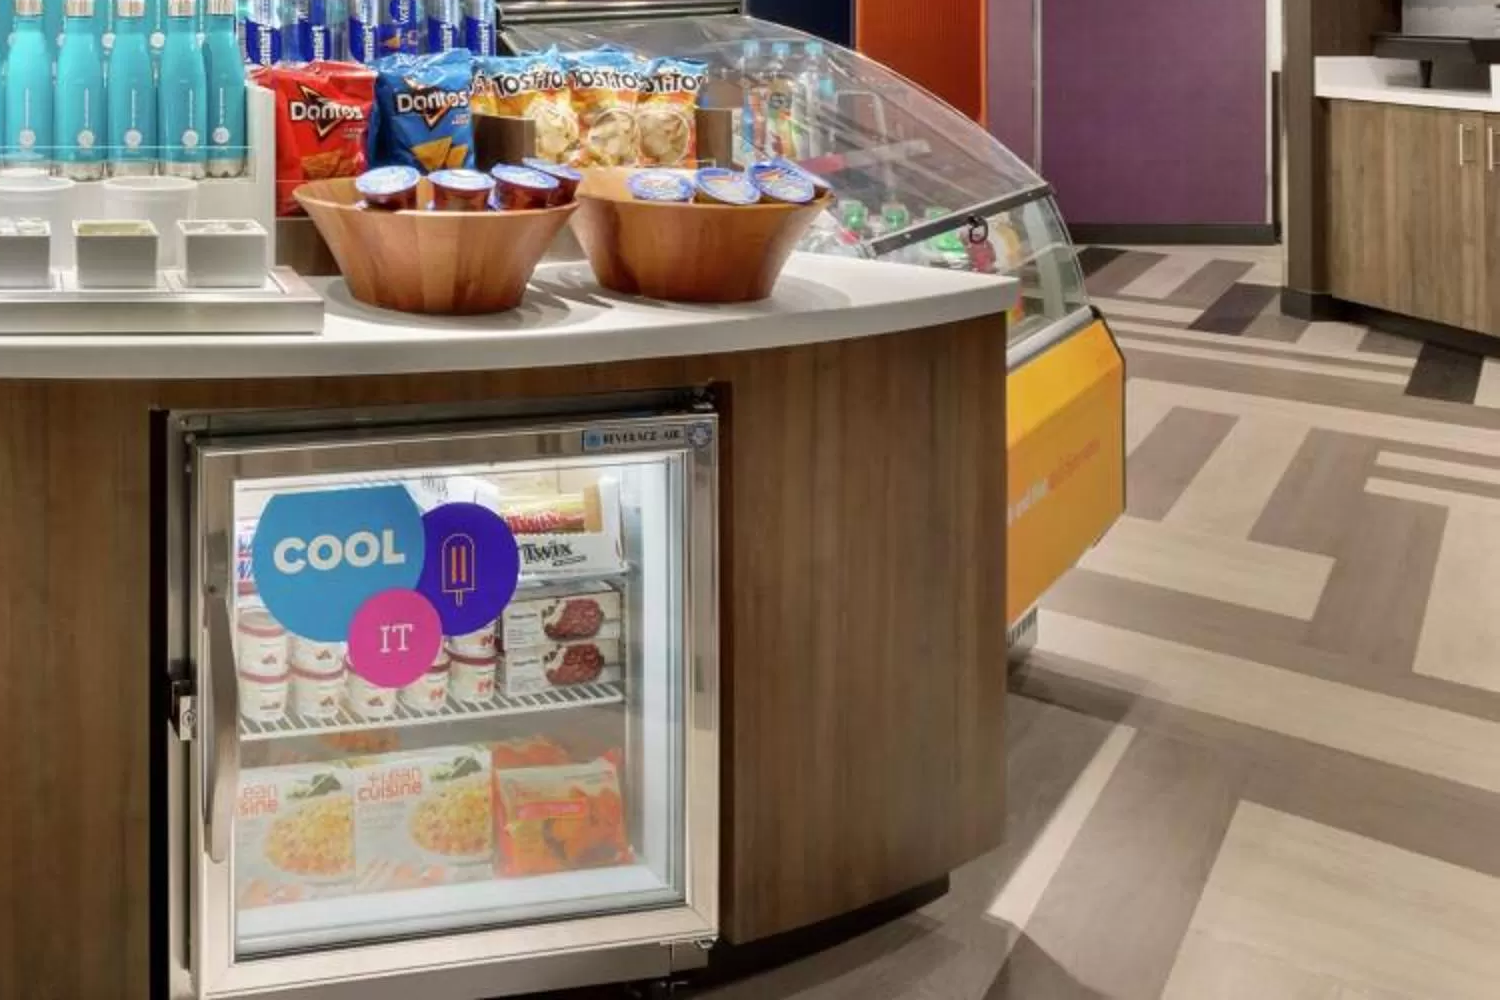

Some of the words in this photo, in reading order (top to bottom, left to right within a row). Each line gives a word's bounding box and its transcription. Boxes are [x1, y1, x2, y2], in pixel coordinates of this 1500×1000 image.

[290, 99, 364, 121] Doritos
[397, 88, 469, 113] Doritos
[273, 528, 407, 575] COOL
[380, 623, 414, 654] IT
